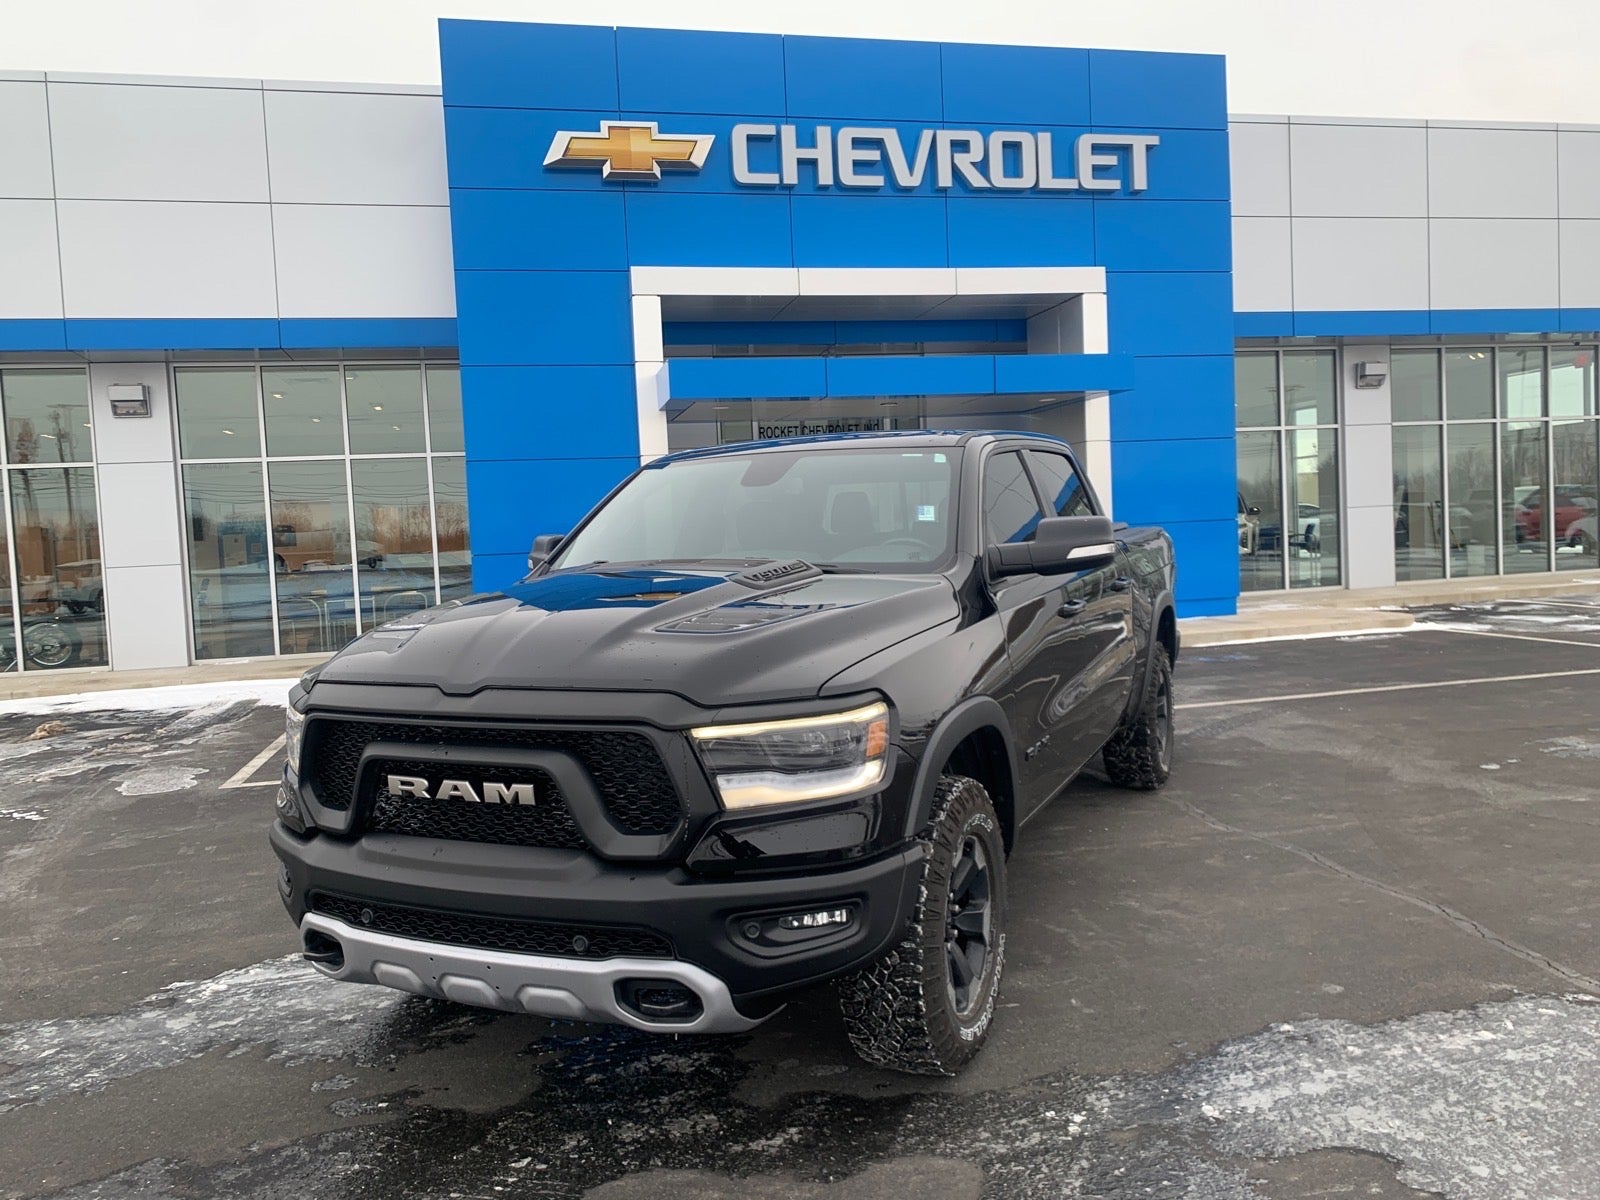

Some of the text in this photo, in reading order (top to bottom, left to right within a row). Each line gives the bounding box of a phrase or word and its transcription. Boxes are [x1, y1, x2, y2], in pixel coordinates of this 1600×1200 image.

[731, 124, 1160, 191] CHEVROLET
[759, 425, 799, 439] ROCKET
[801, 423, 860, 436] CHEVROLET
[387, 774, 536, 806] RAM
